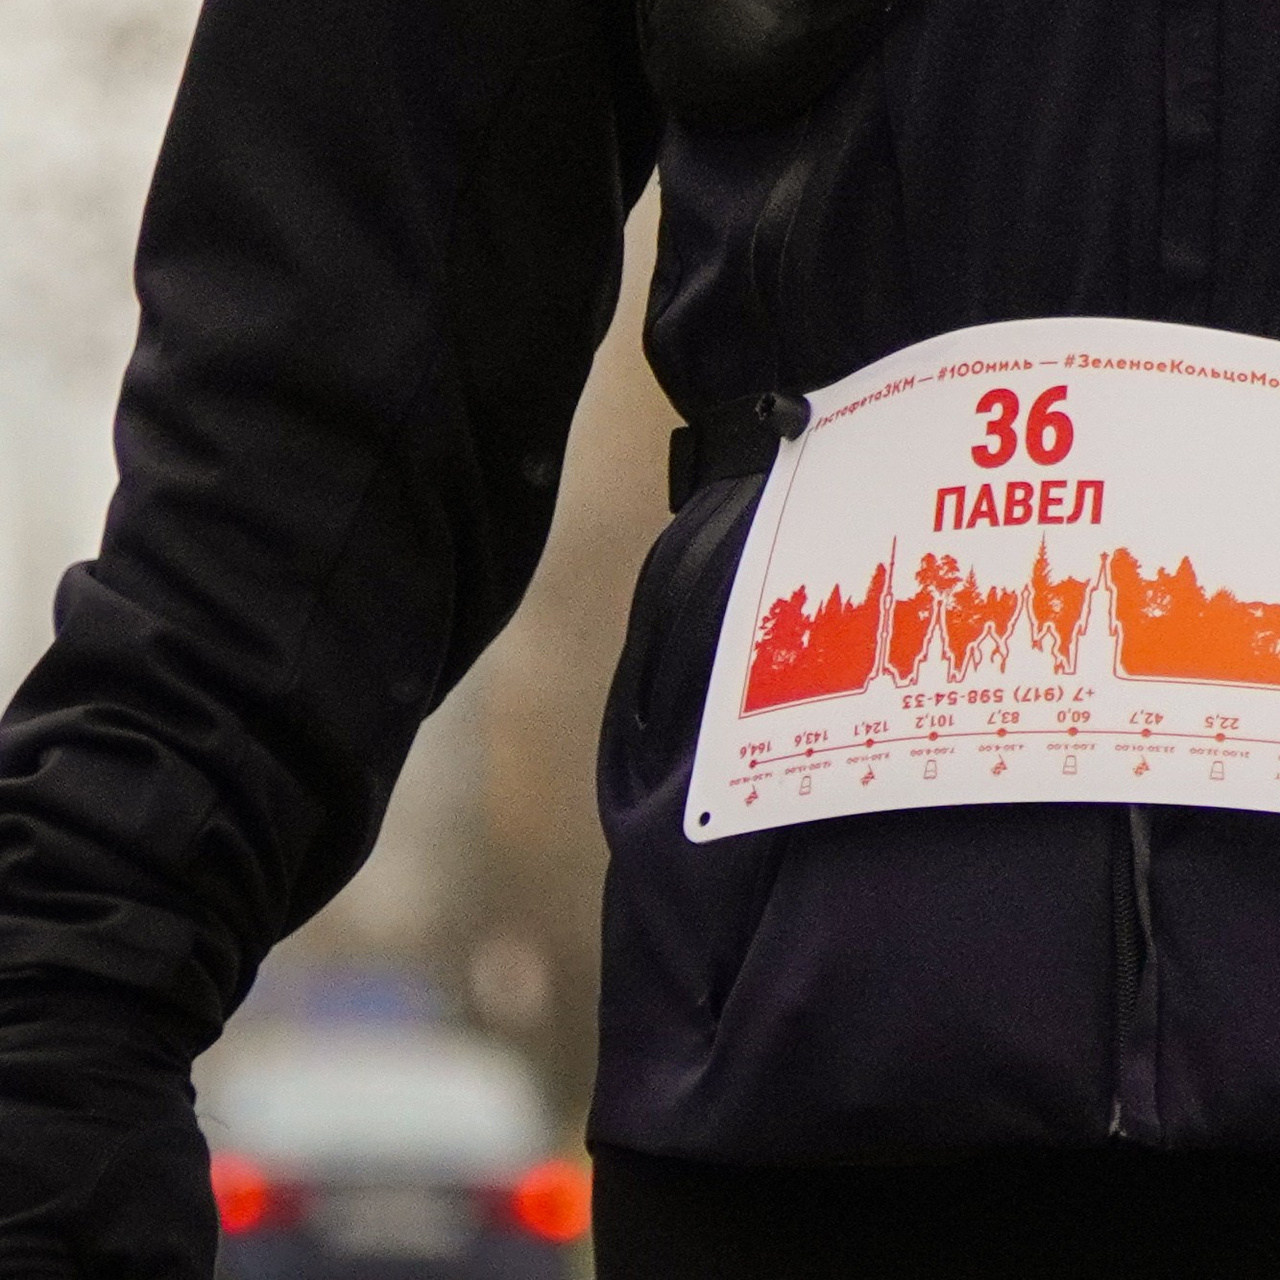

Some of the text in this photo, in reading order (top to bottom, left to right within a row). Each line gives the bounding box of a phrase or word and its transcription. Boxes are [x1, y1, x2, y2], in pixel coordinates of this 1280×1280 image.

[971, 385, 1074, 469] 36
[933, 480, 1105, 532] ПАВЕЛ
[902, 689, 1004, 710] 598-54-33
[1013, 685, 1065, 703] (917)
[915, 713, 955, 729] 101,2
[987, 709, 1021, 725] 83,7
[1056, 707, 1091, 724] 60,0
[1129, 709, 1164, 726] 42,7
[1204, 713, 1240, 730] 22,5
[854, 720, 889, 737] 124,1
[794, 730, 829, 747] 143,6
[739, 741, 772, 759] 164,6
